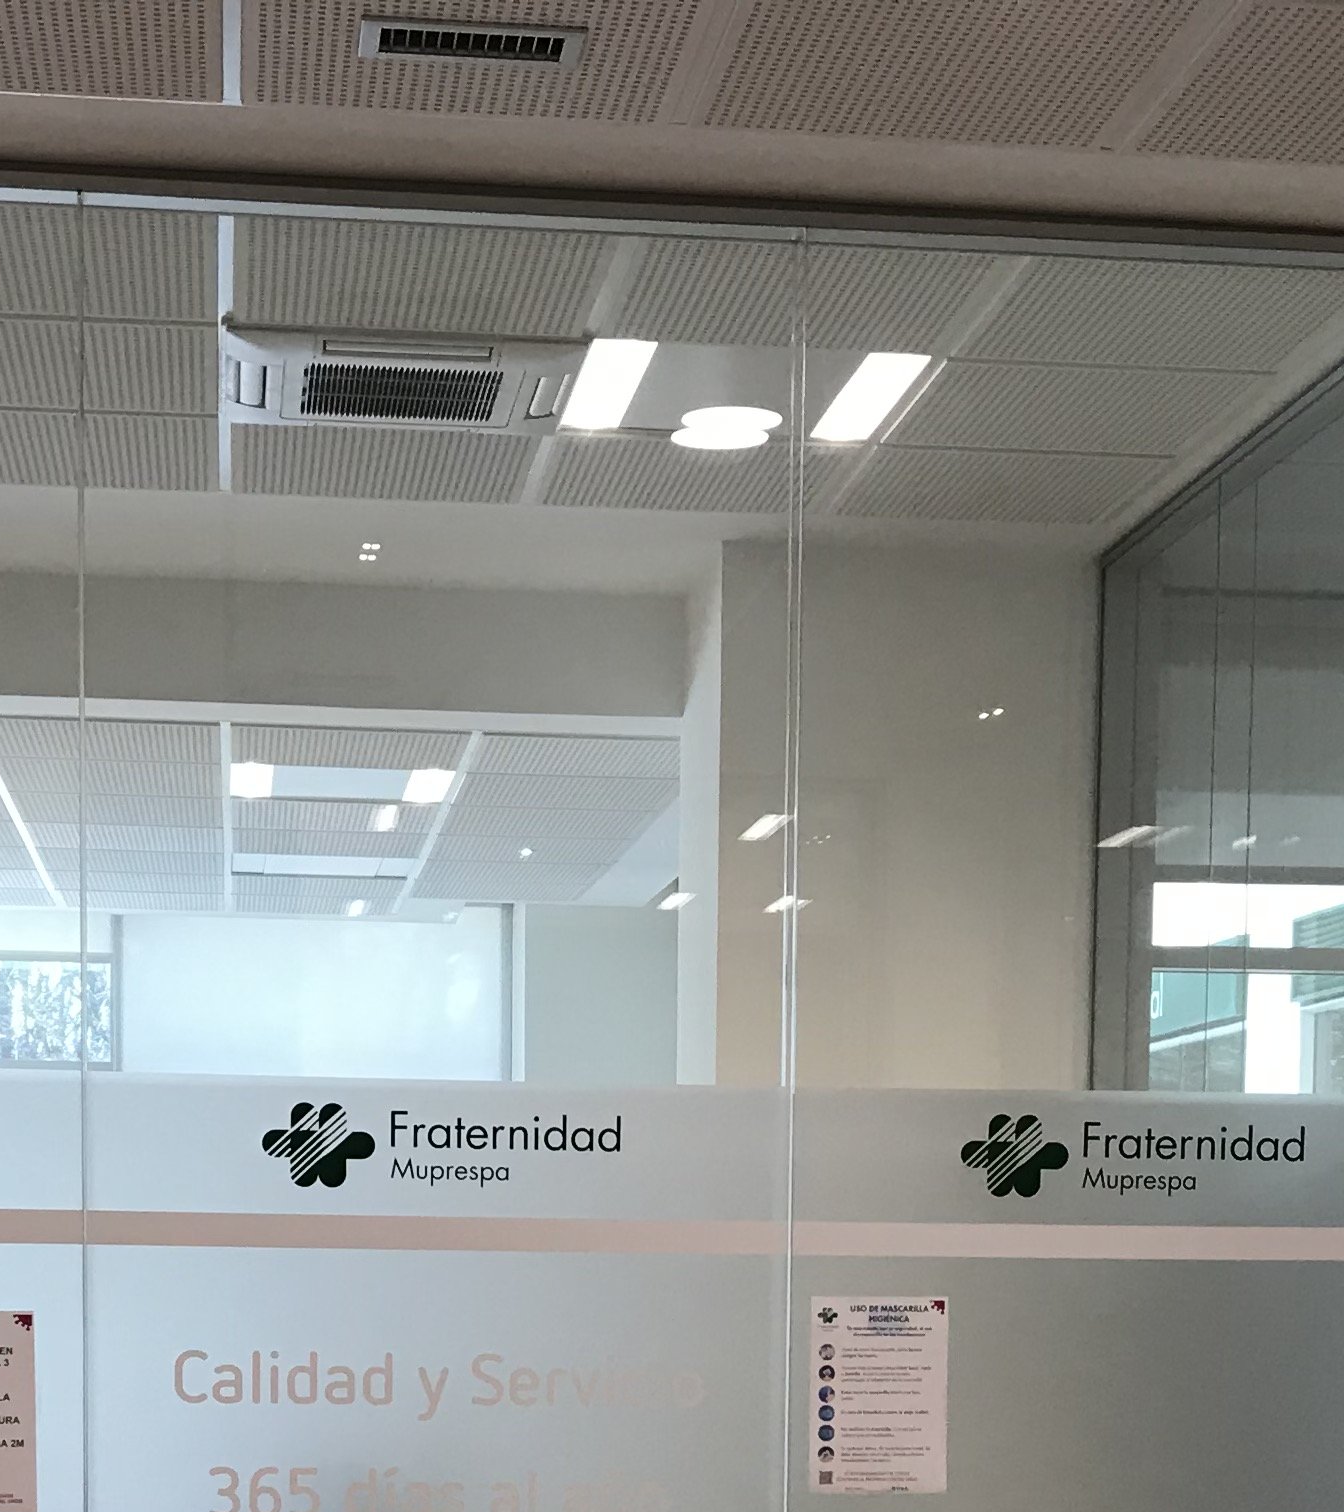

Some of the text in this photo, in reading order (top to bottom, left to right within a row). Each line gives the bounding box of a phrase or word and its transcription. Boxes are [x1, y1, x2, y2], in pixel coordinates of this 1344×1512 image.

[390, 1110, 622, 1154] Fraternidad
[1083, 1122, 1307, 1163] Fraternidad
[390, 1158, 511, 1187] Muprespa
[1082, 1167, 1198, 1196] Muprespa
[850, 1305, 929, 1313] USO DE MASCARILLA
[0, 1347, 13, 1355] EN
[3, 1358, 10, 1367] 3
[174, 1349, 393, 1406] Calidad
[417, 1366, 449, 1421] y
[10, 1439, 25, 1448] 2M
